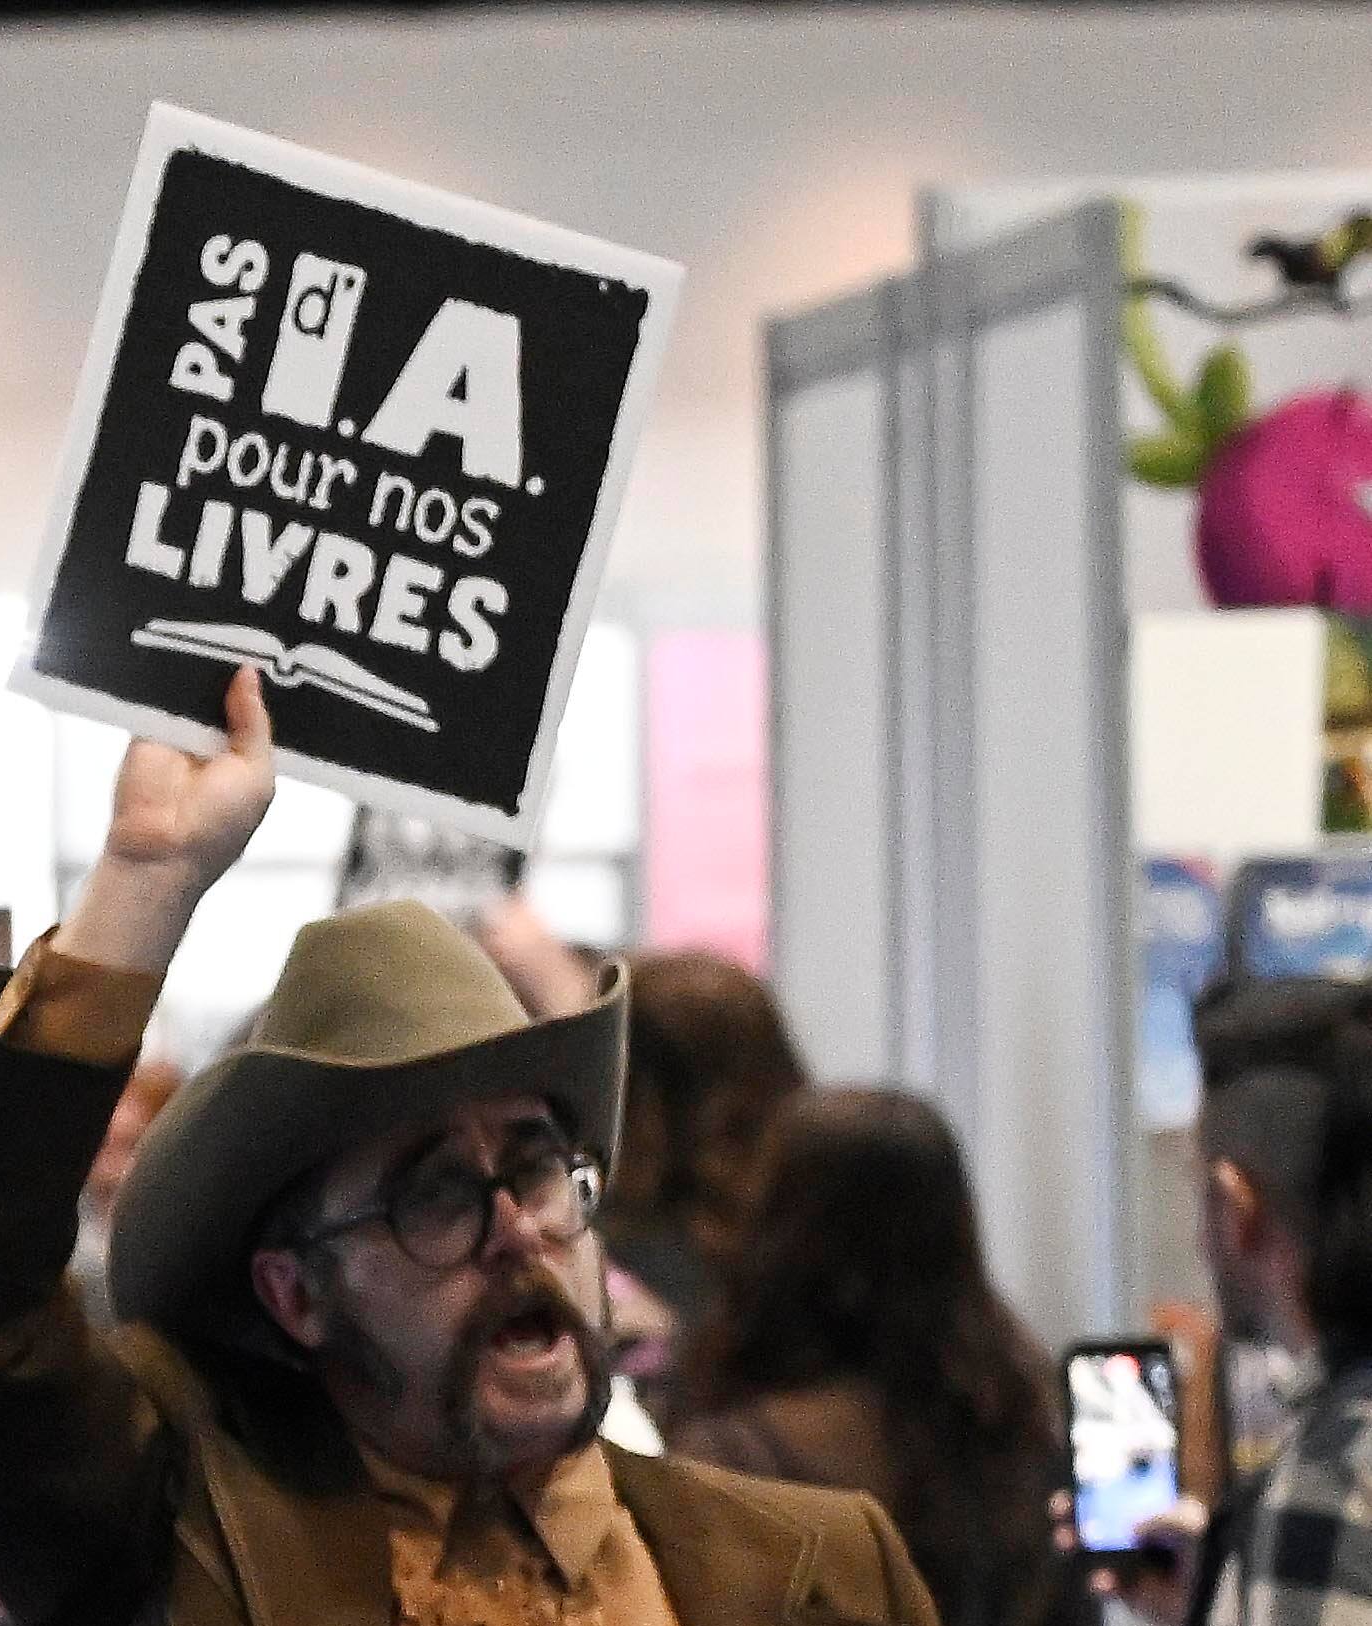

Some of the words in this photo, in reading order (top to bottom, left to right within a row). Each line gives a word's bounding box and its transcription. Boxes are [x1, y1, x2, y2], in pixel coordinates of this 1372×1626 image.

[168, 232, 271, 401] PAS
[177, 413, 357, 508] pour
[369, 472, 500, 557] nos
[125, 480, 510, 671] LIVRES
